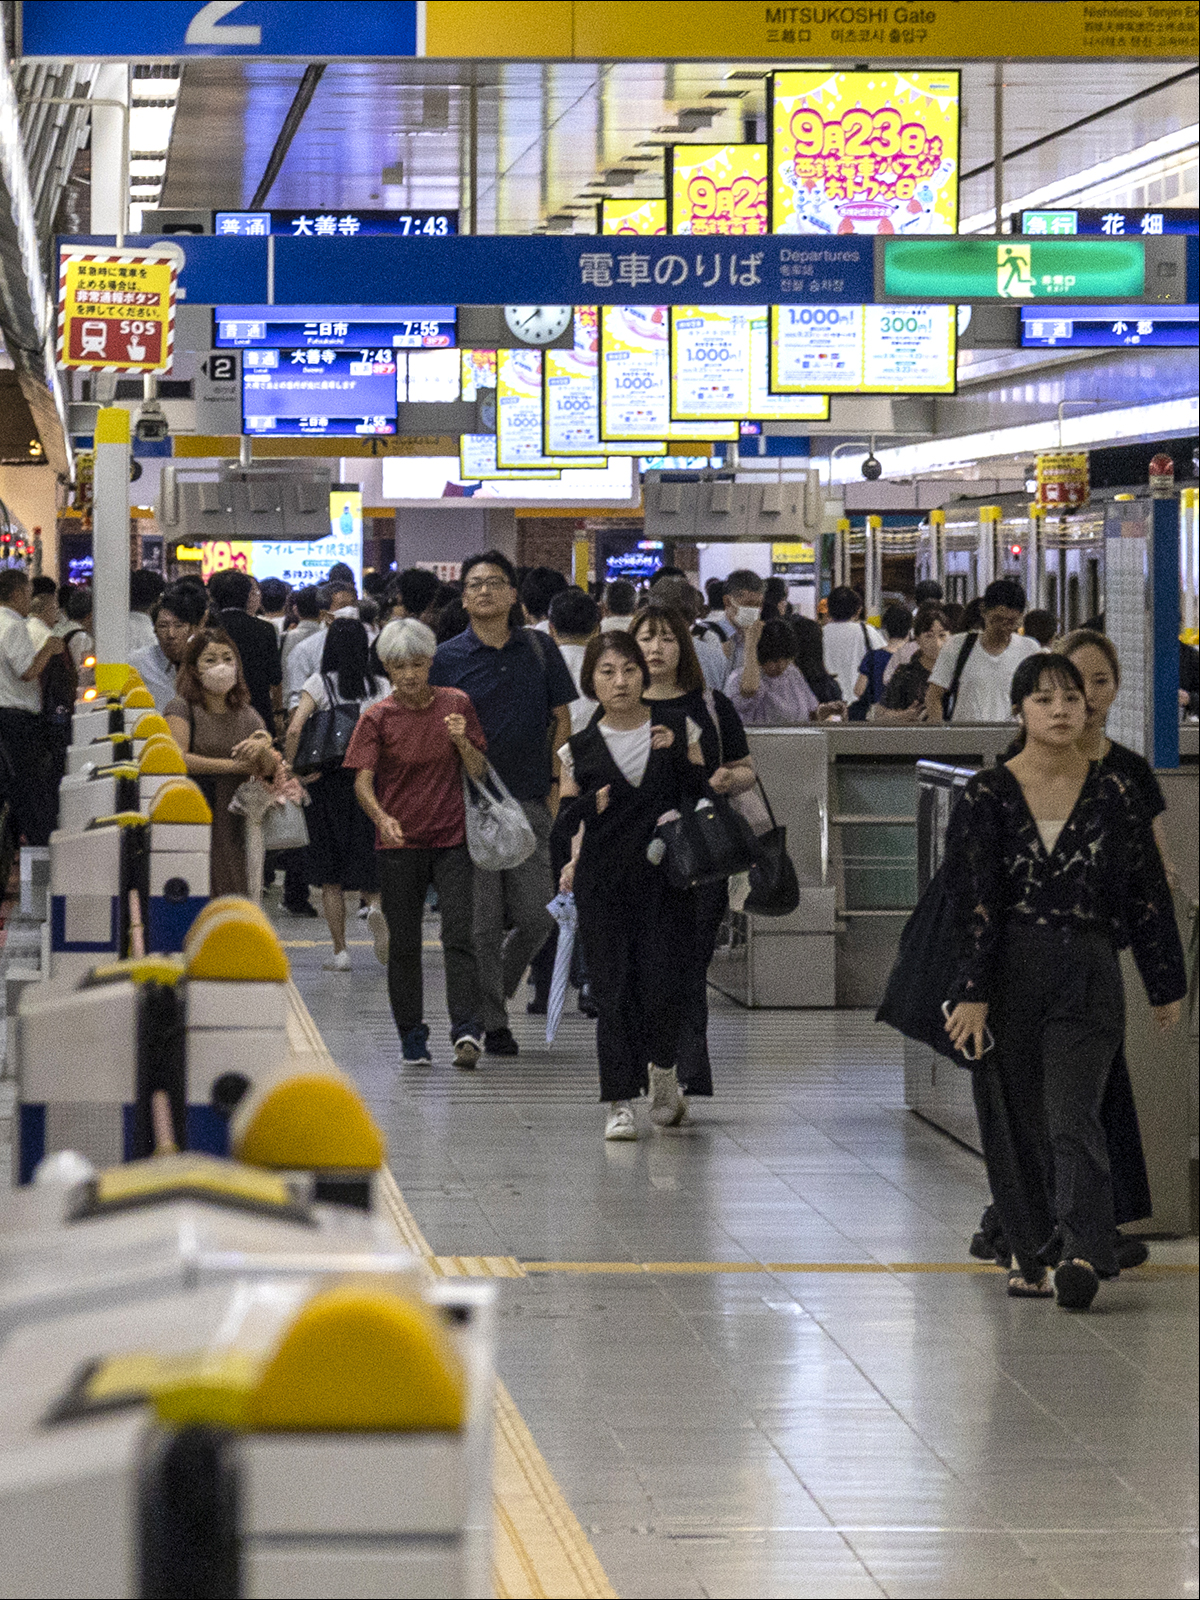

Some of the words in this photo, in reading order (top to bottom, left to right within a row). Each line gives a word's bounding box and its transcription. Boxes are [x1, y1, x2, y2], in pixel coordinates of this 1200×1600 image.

[765, 7, 888, 24] MITSUKOSHI
[894, 7, 937, 24] Gate
[790, 107, 943, 157] 9月23日は
[291, 215, 361, 235] 大善寺
[399, 216, 449, 235] 7:43
[1027, 216, 1074, 235] 急行
[1101, 213, 1164, 235] 花畑
[779, 249, 860, 263] Departures
[77, 265, 147, 279] 緊急時に電車を
[579, 251, 765, 288] 電車のりば
[76, 290, 159, 305] 非常通報ボタン
[120, 321, 156, 335] SOS
[303, 322, 349, 337] 二日市
[402, 321, 439, 337] 7:55
[291, 349, 337, 364] 大善寺
[360, 349, 392, 363] 7:43
[214, 359, 232, 378] 2
